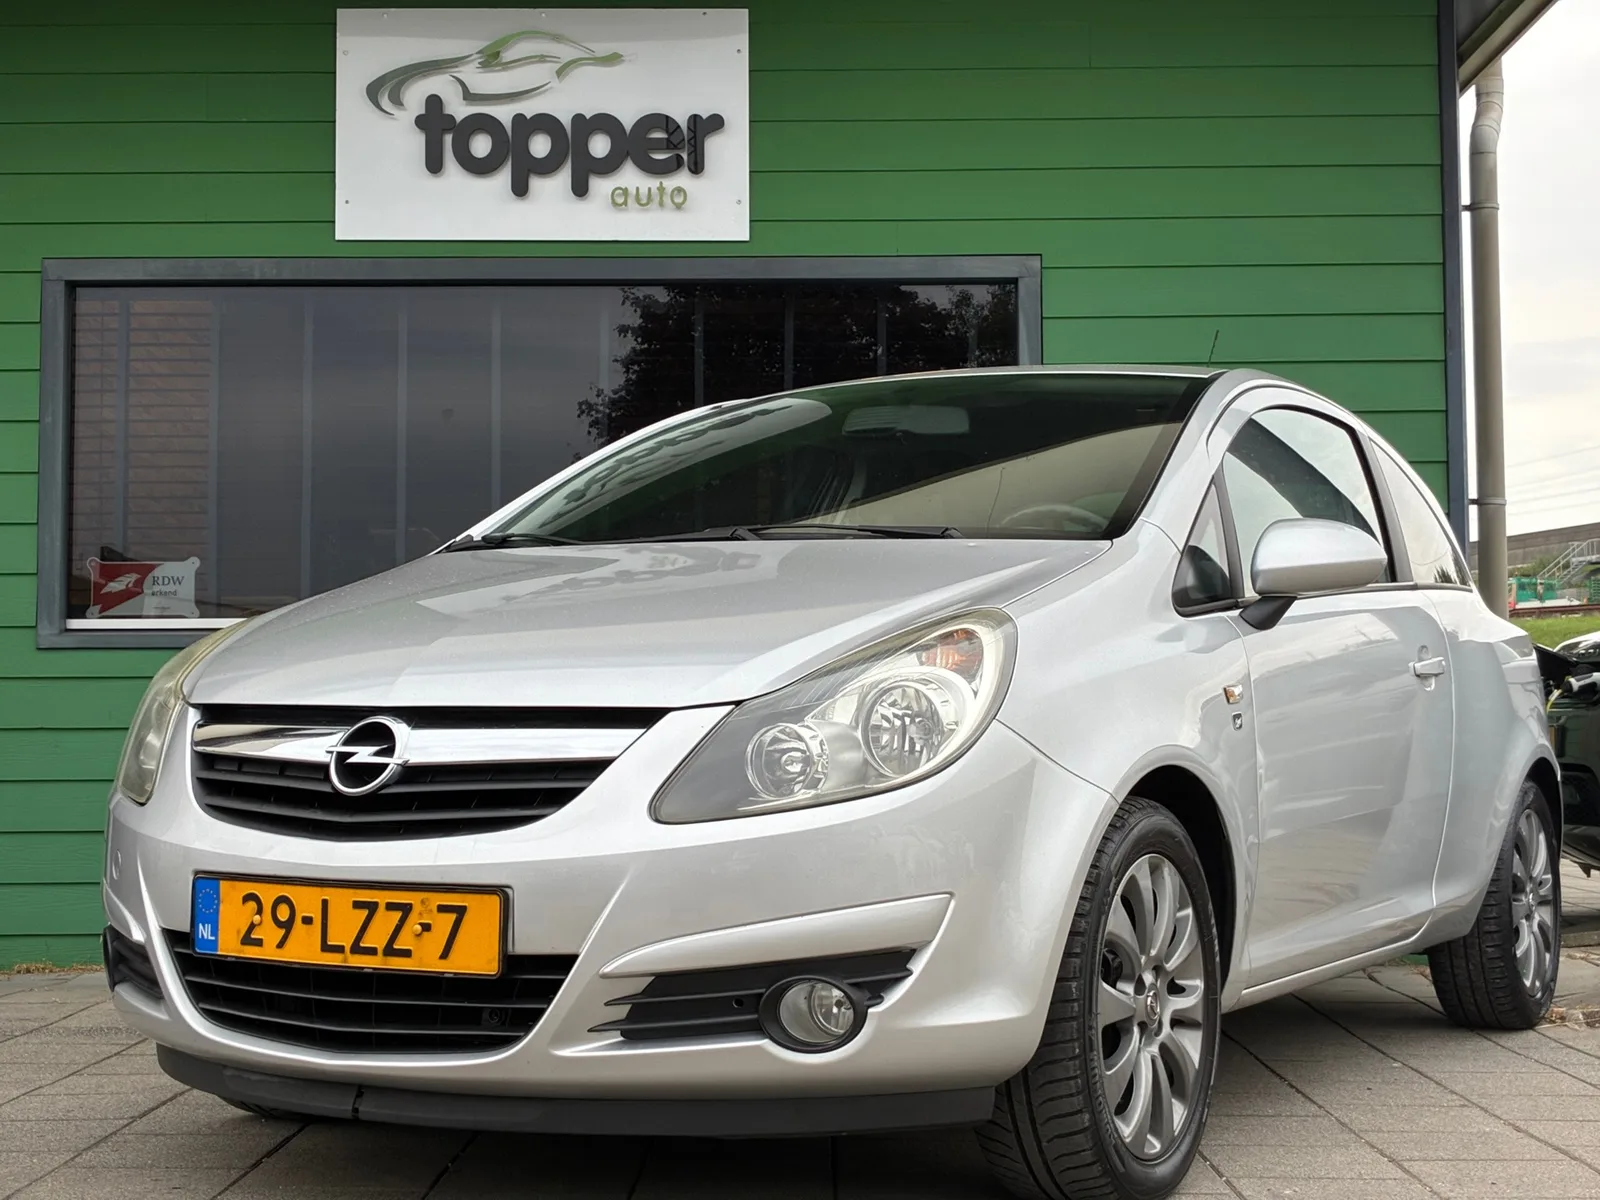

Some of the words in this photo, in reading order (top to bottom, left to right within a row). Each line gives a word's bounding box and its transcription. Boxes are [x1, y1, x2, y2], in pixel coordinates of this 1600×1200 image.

[414, 93, 725, 198] topper
[610, 180, 688, 209] auto
[152, 575, 185, 586] RDW
[198, 923, 216, 941] NL
[239, 892, 468, 960] 29-LZZ-7
